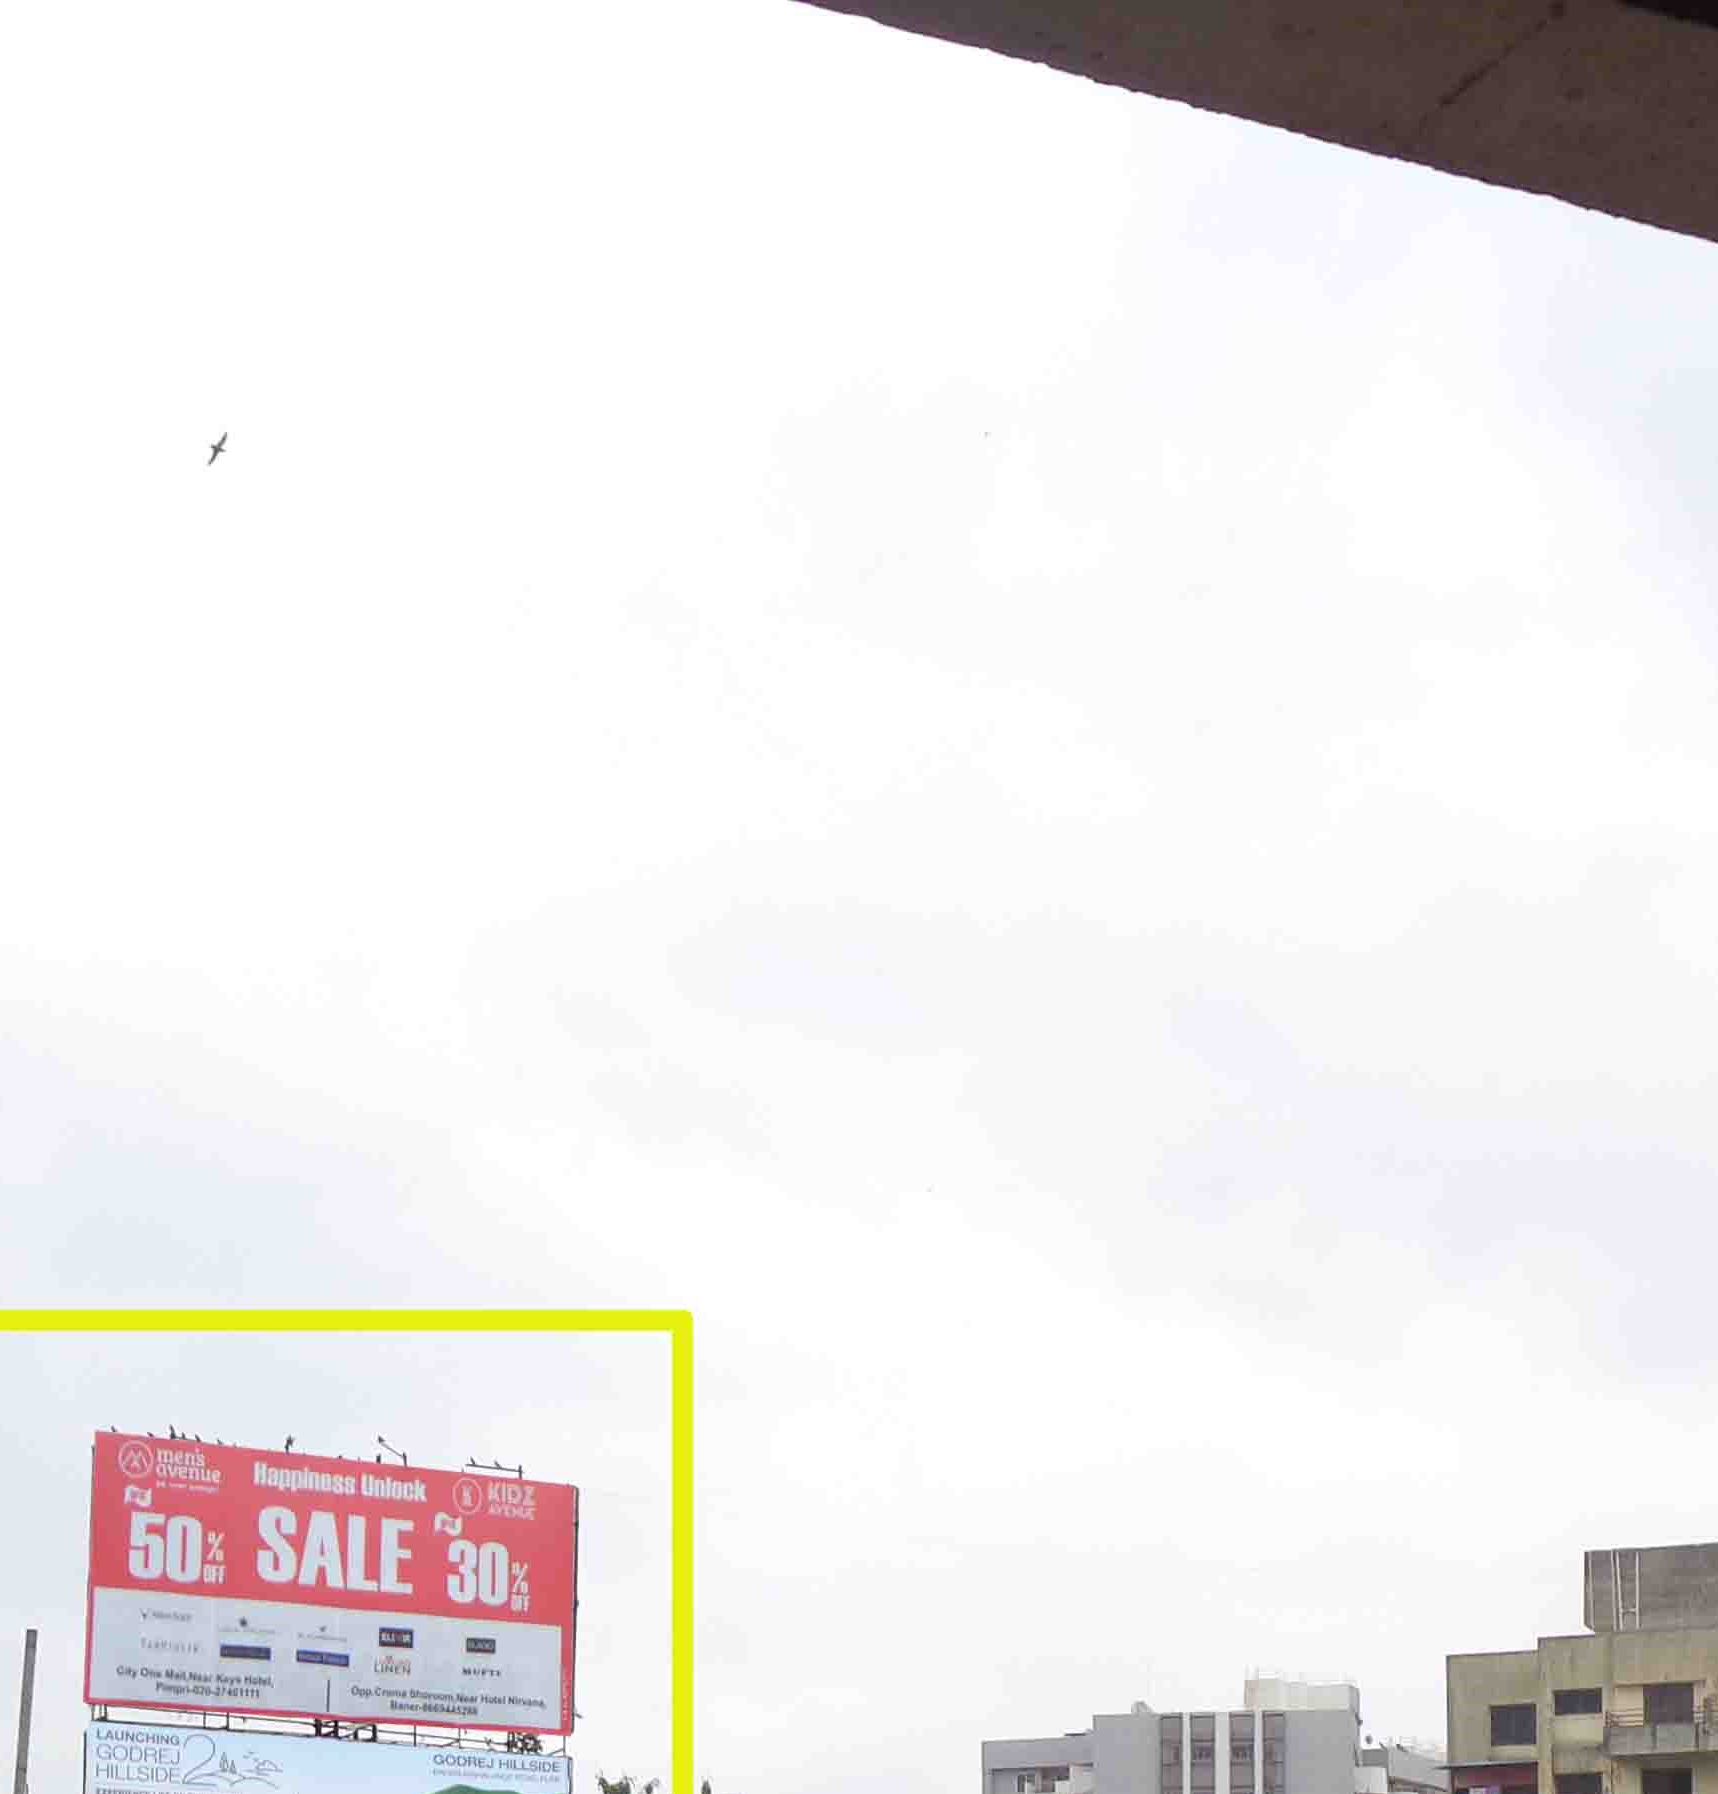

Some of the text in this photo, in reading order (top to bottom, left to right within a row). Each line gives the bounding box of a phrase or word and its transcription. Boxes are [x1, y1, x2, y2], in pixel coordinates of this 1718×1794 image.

[156, 1463, 222, 1483] avenue
[253, 1461, 356, 1495] Happiness
[361, 1473, 427, 1502] Unlock
[488, 1482, 535, 1506] KIDZ
[257, 1505, 414, 1595] SALE
[96, 1729, 180, 1746] LAUNCHING
[96, 1743, 180, 1765] GODREJ
[433, 1754, 561, 1773] GODREJ HILLSIDE
[95, 1763, 181, 1784] HILLSIDE
